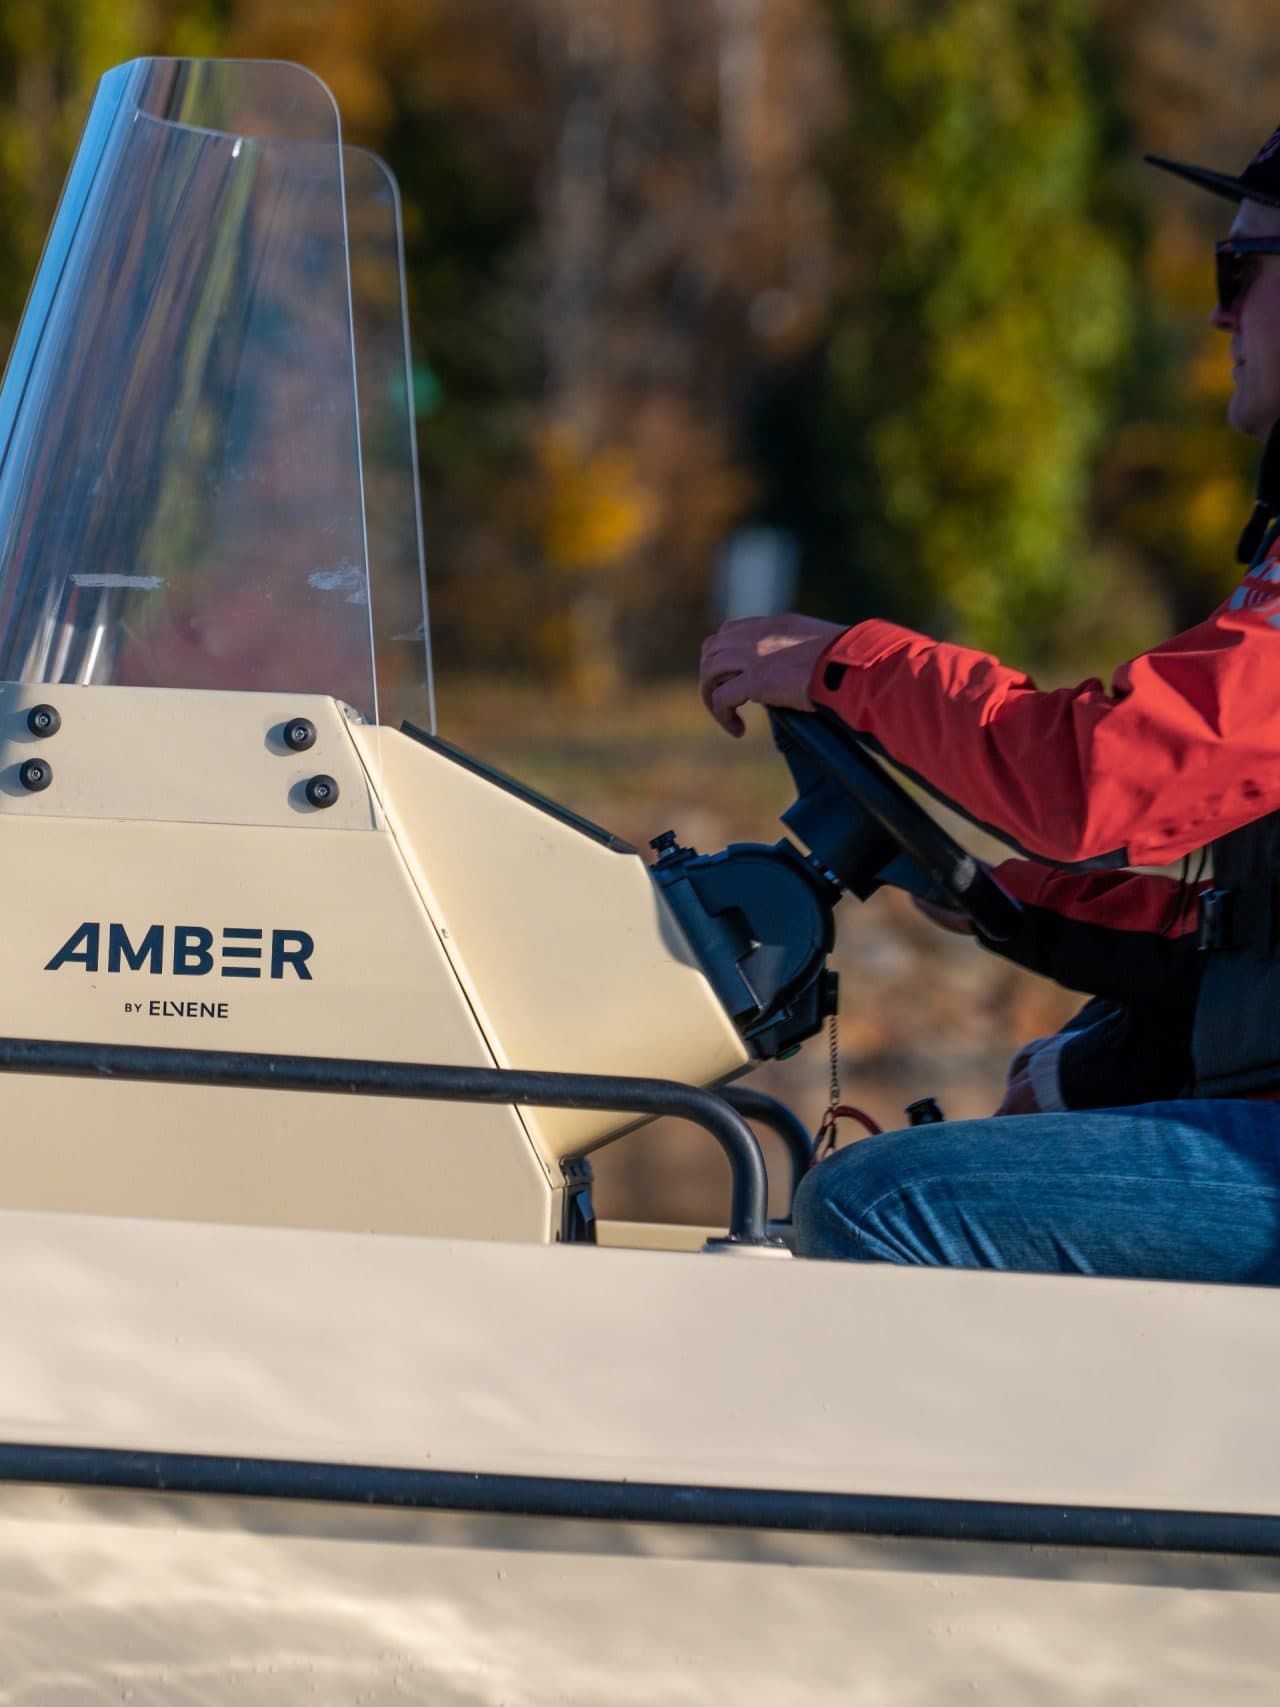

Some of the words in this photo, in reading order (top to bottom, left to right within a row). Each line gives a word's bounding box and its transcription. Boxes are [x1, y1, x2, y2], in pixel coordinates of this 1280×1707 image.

[43, 921, 315, 981] AMBER
[124, 1002, 142, 1013] BY
[149, 1000, 229, 1018] ELVENE
